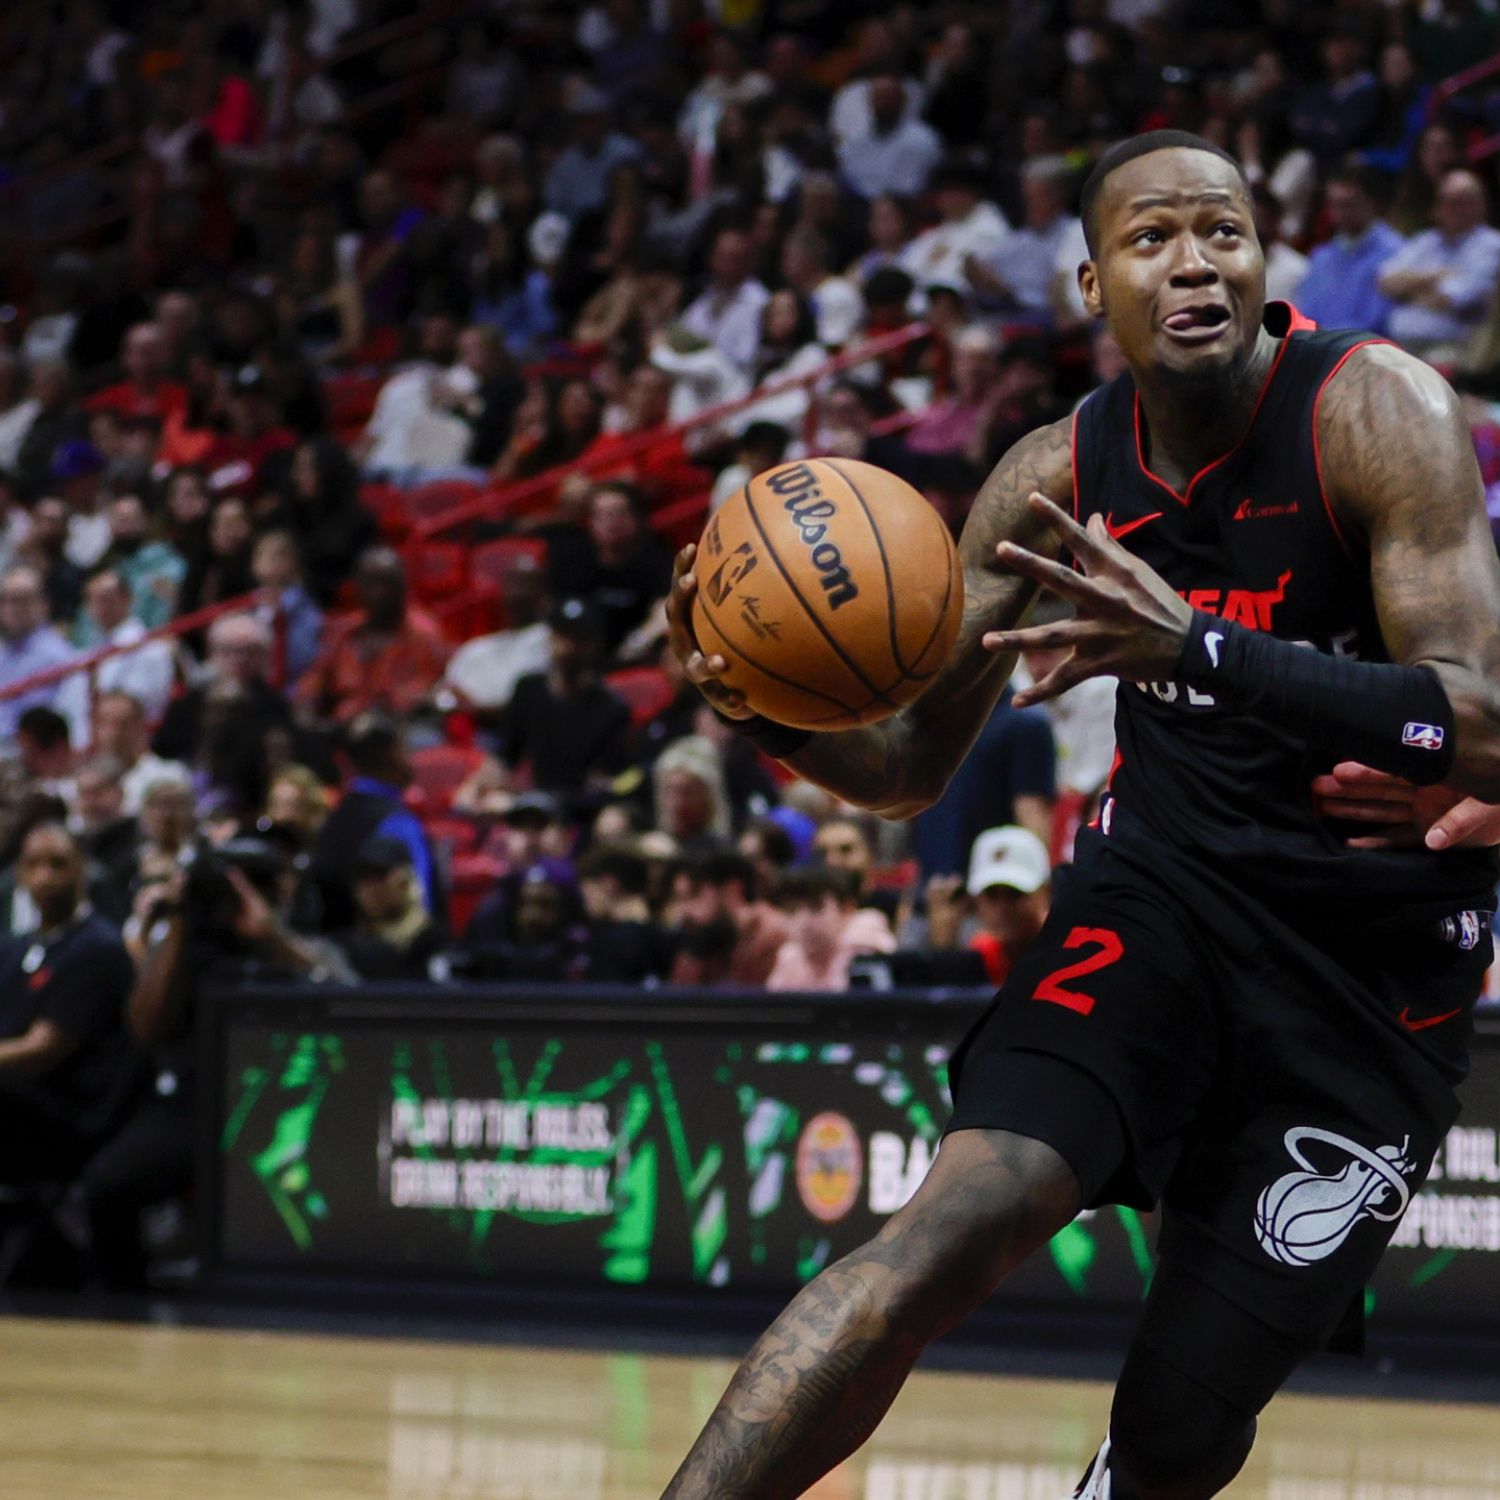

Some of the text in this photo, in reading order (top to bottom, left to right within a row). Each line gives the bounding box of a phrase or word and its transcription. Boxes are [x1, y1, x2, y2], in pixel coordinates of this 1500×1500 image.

[765, 462, 859, 611] Wilson
[1176, 568, 1293, 632] EAT
[1032, 926, 1125, 1017] 2
[868, 1131, 941, 1214] BA
